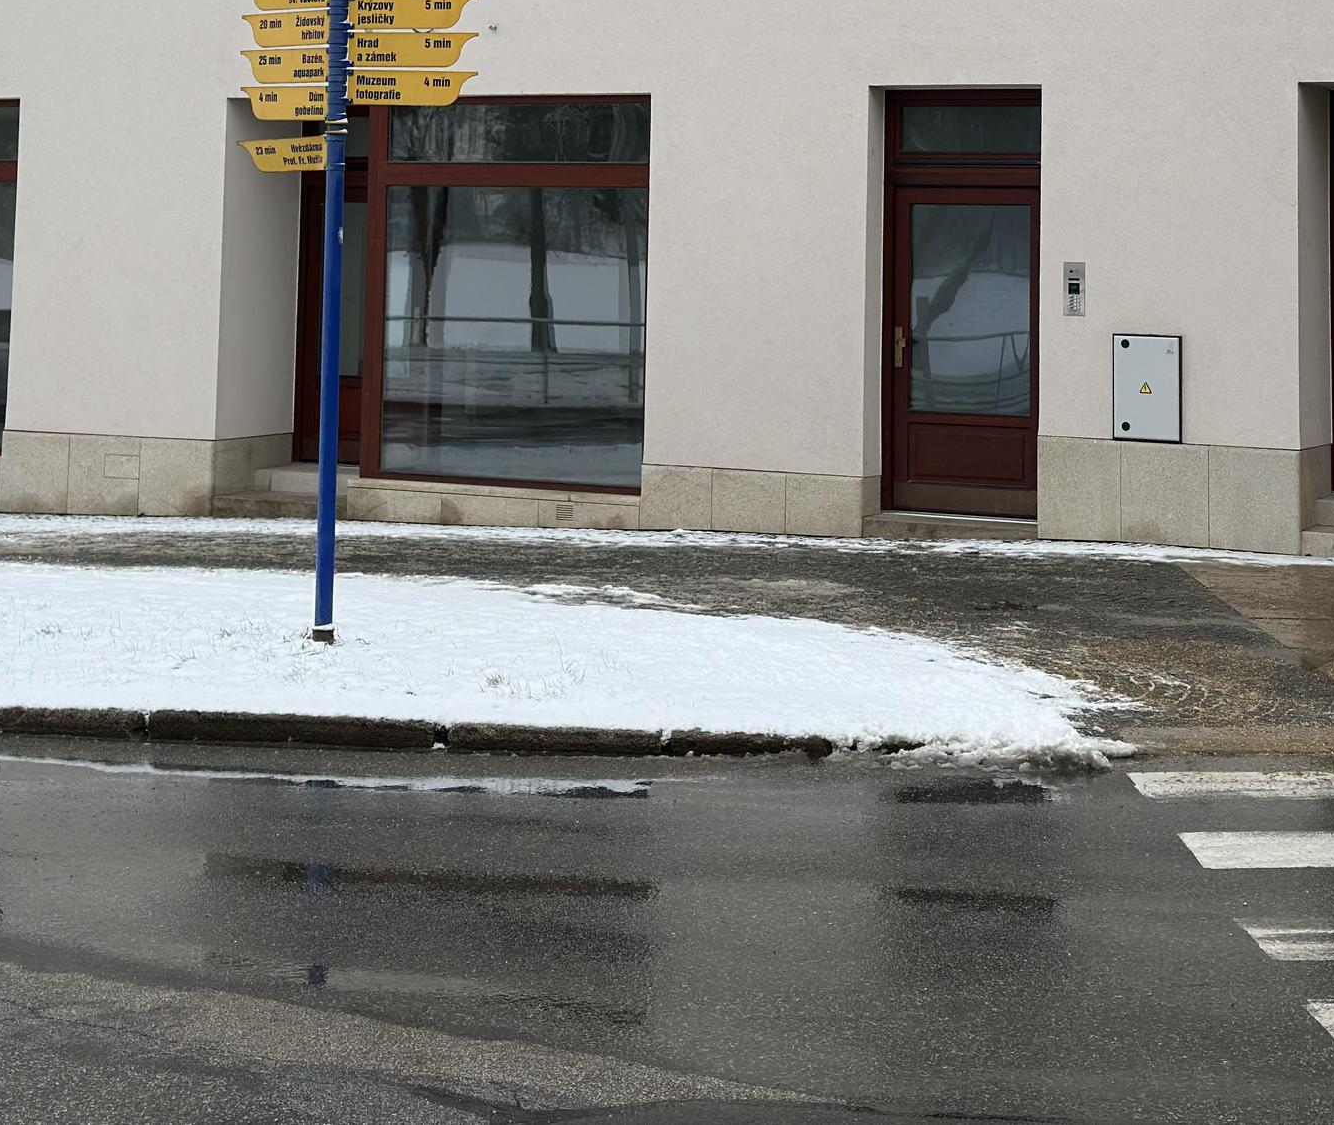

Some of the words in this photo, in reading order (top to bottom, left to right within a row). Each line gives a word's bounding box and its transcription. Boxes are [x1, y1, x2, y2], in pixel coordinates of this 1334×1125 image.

[358, 0, 394, 11] Krýzovy
[425, 0, 431, 10] 5
[434, 0, 452, 10] min
[260, 19, 267, 29] 20
[269, 18, 282, 28] min
[295, 15, 325, 27] Židovský
[357, 13, 394, 25] jesličky
[301, 29, 325, 40] hřbitov
[357, 38, 379, 48] Hrad
[424, 38, 430, 48] 5
[433, 38, 451, 48] min
[258, 55, 267, 65] 25
[268, 55, 281, 65] min
[357, 53, 363, 62] a
[365, 51, 397, 62] zámek
[293, 67, 324, 79] aquapark
[356, 75, 396, 86] Muzeum
[424, 77, 430, 87] 4
[432, 76, 451, 87] min
[259, 92, 263, 102] 4
[265, 92, 278, 102] min
[309, 91, 324, 102] Dům
[356, 88, 401, 101] fotografie
[265, 145, 276, 155] min
